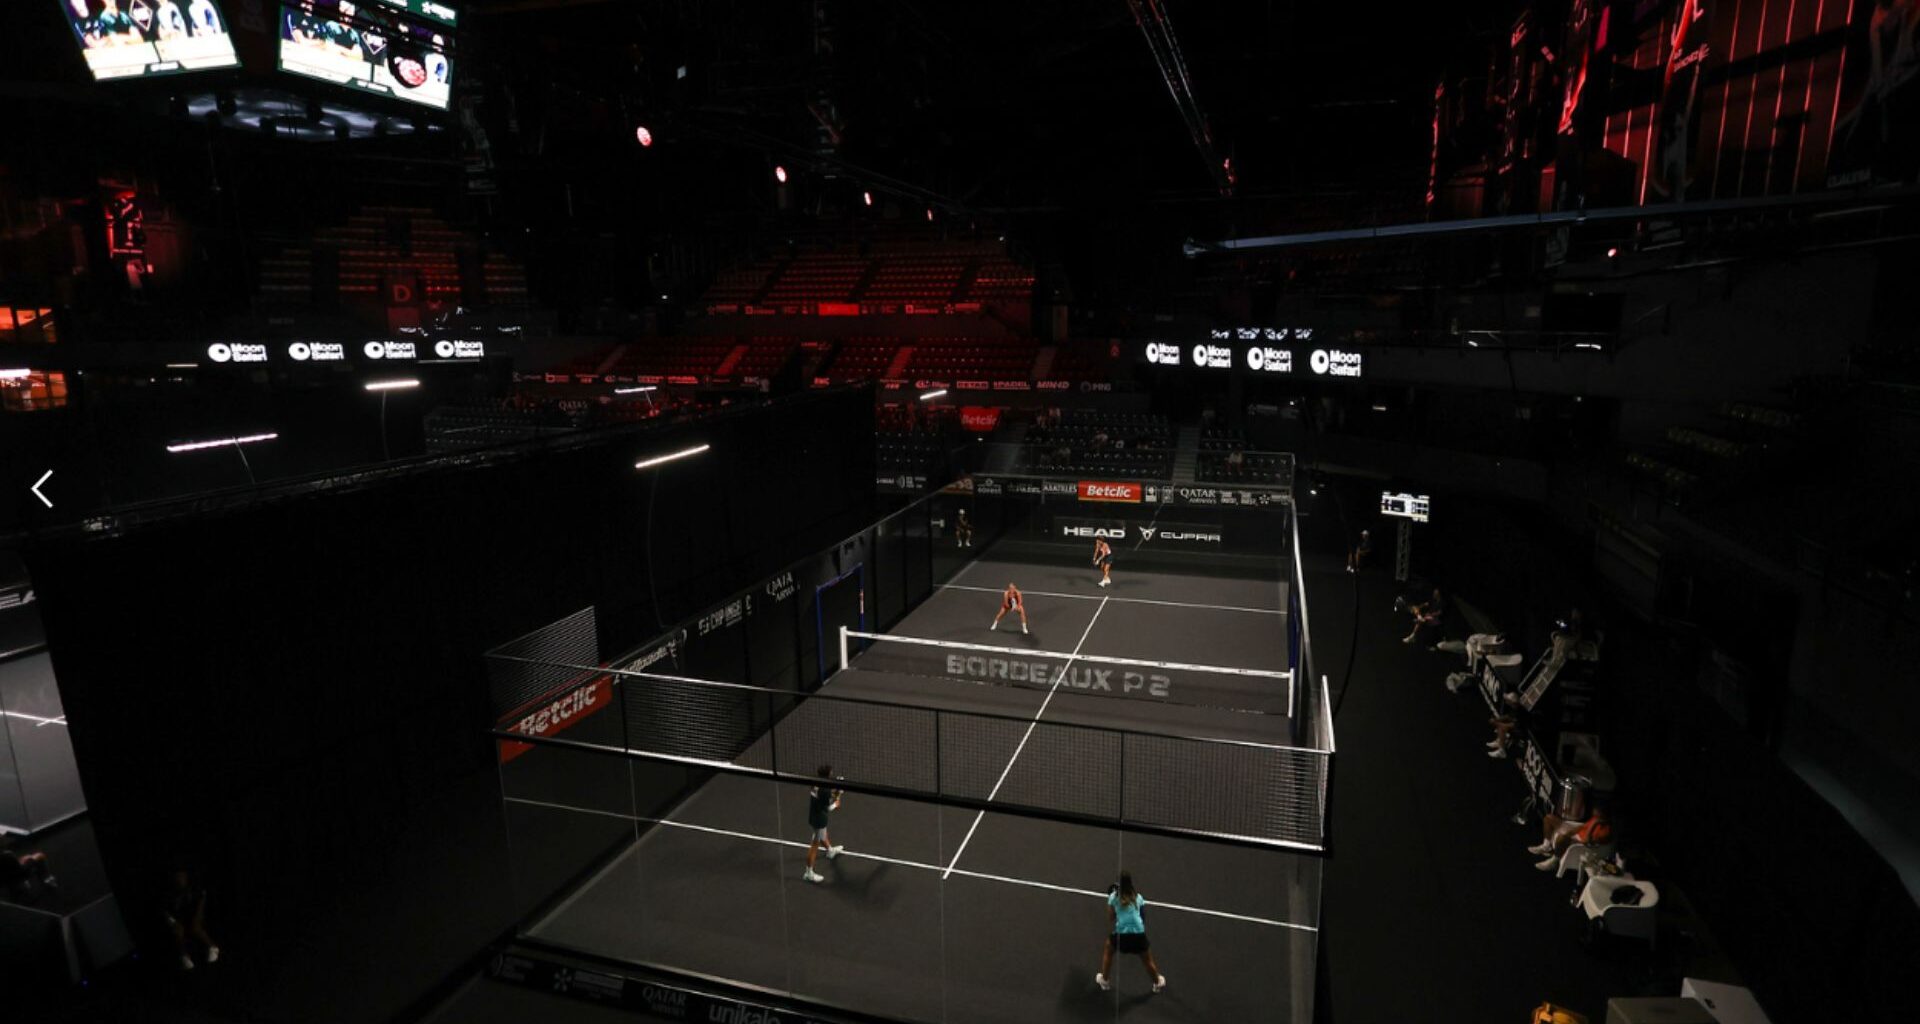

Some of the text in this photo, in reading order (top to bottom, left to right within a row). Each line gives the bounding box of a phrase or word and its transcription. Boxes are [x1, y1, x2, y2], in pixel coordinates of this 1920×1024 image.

[1158, 343, 1179, 354] Moon
[1207, 345, 1231, 357] Moon
[1264, 347, 1291, 360] Moon
[1329, 350, 1361, 363] Moon
[1264, 359, 1292, 372] Safari
[1329, 362, 1361, 377] Safari
[1087, 485, 1131, 498] Betclic
[1180, 488, 1216, 501] QATAR
[1064, 526, 1126, 538] HEAD
[1160, 531, 1221, 542] CUPRA
[947, 654, 1112, 692] BORDEAUX
[519, 683, 598, 739] Betclic
[642, 985, 687, 1006] QATAR
